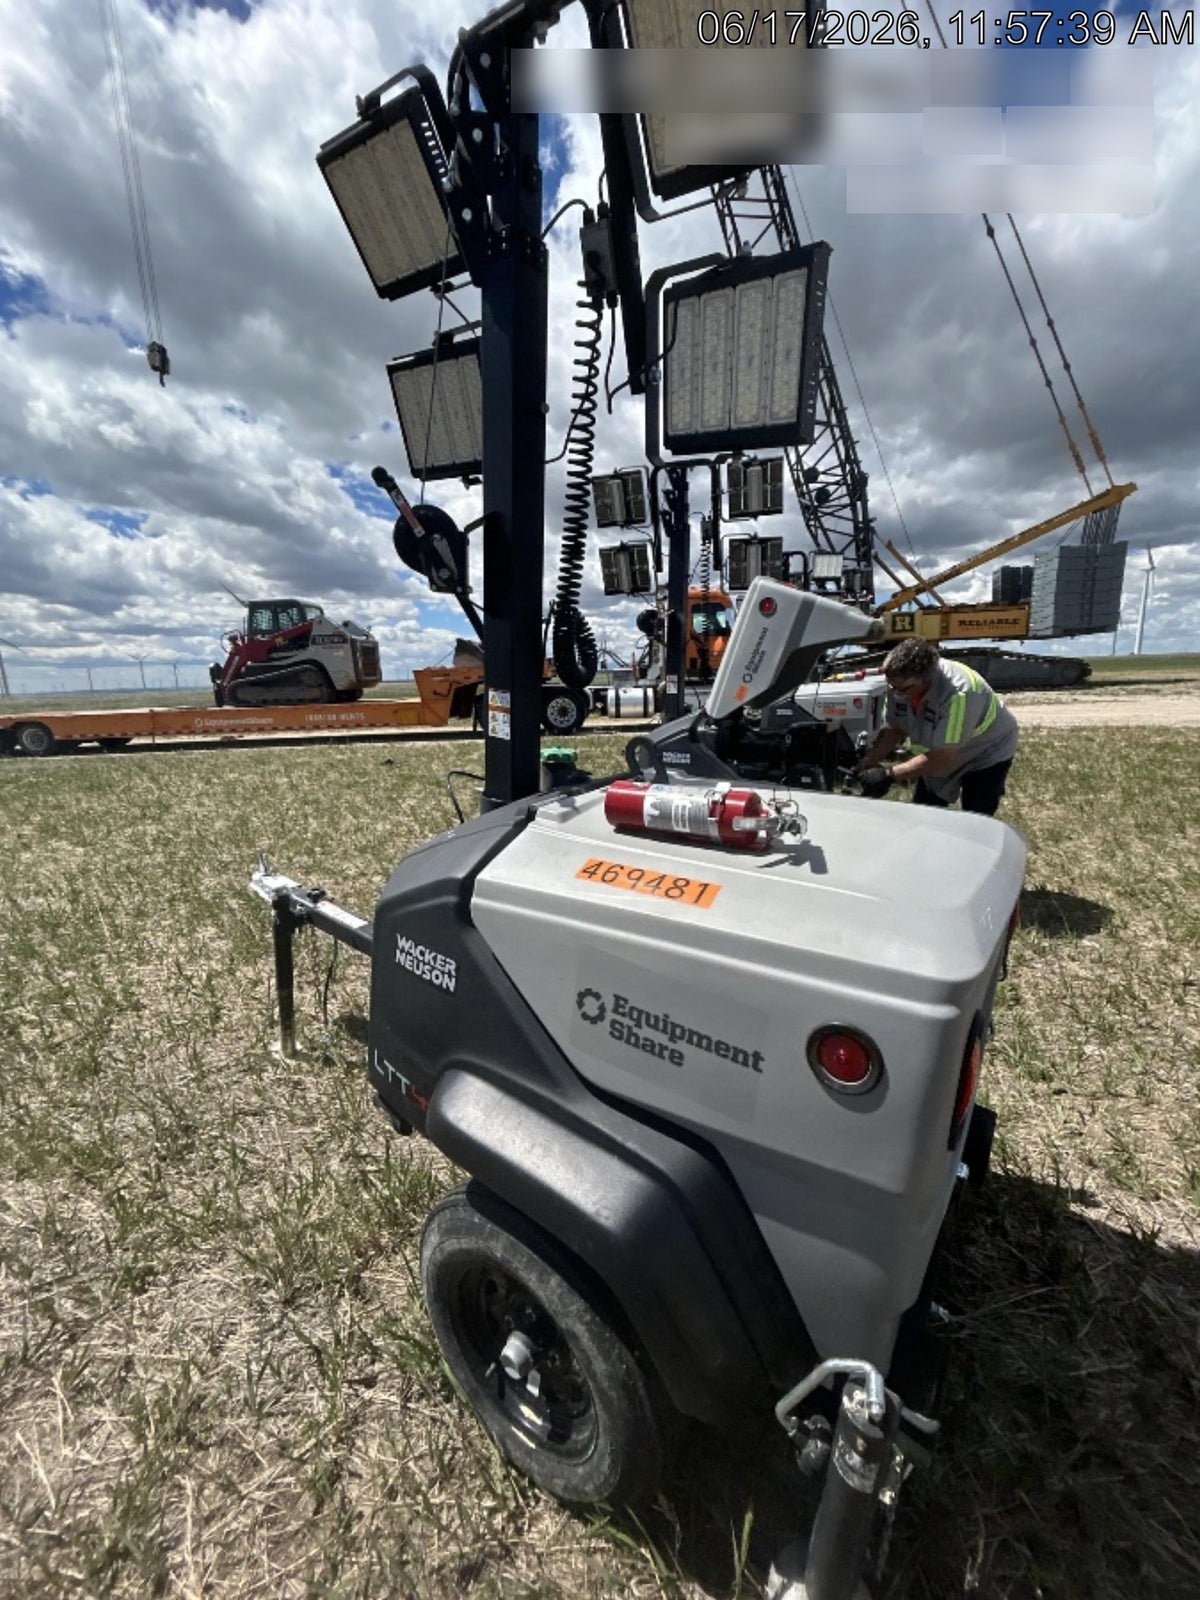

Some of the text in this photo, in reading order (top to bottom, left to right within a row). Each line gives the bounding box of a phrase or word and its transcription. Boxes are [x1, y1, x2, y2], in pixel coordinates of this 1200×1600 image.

[957, 618, 1021, 627] RELIABLE
[581, 860, 711, 905] 469481
[395, 932, 457, 977] WACKER
[395, 949, 457, 993] NEUSON
[609, 1016, 685, 1068] Share
[610, 993, 765, 1074] Equipment
